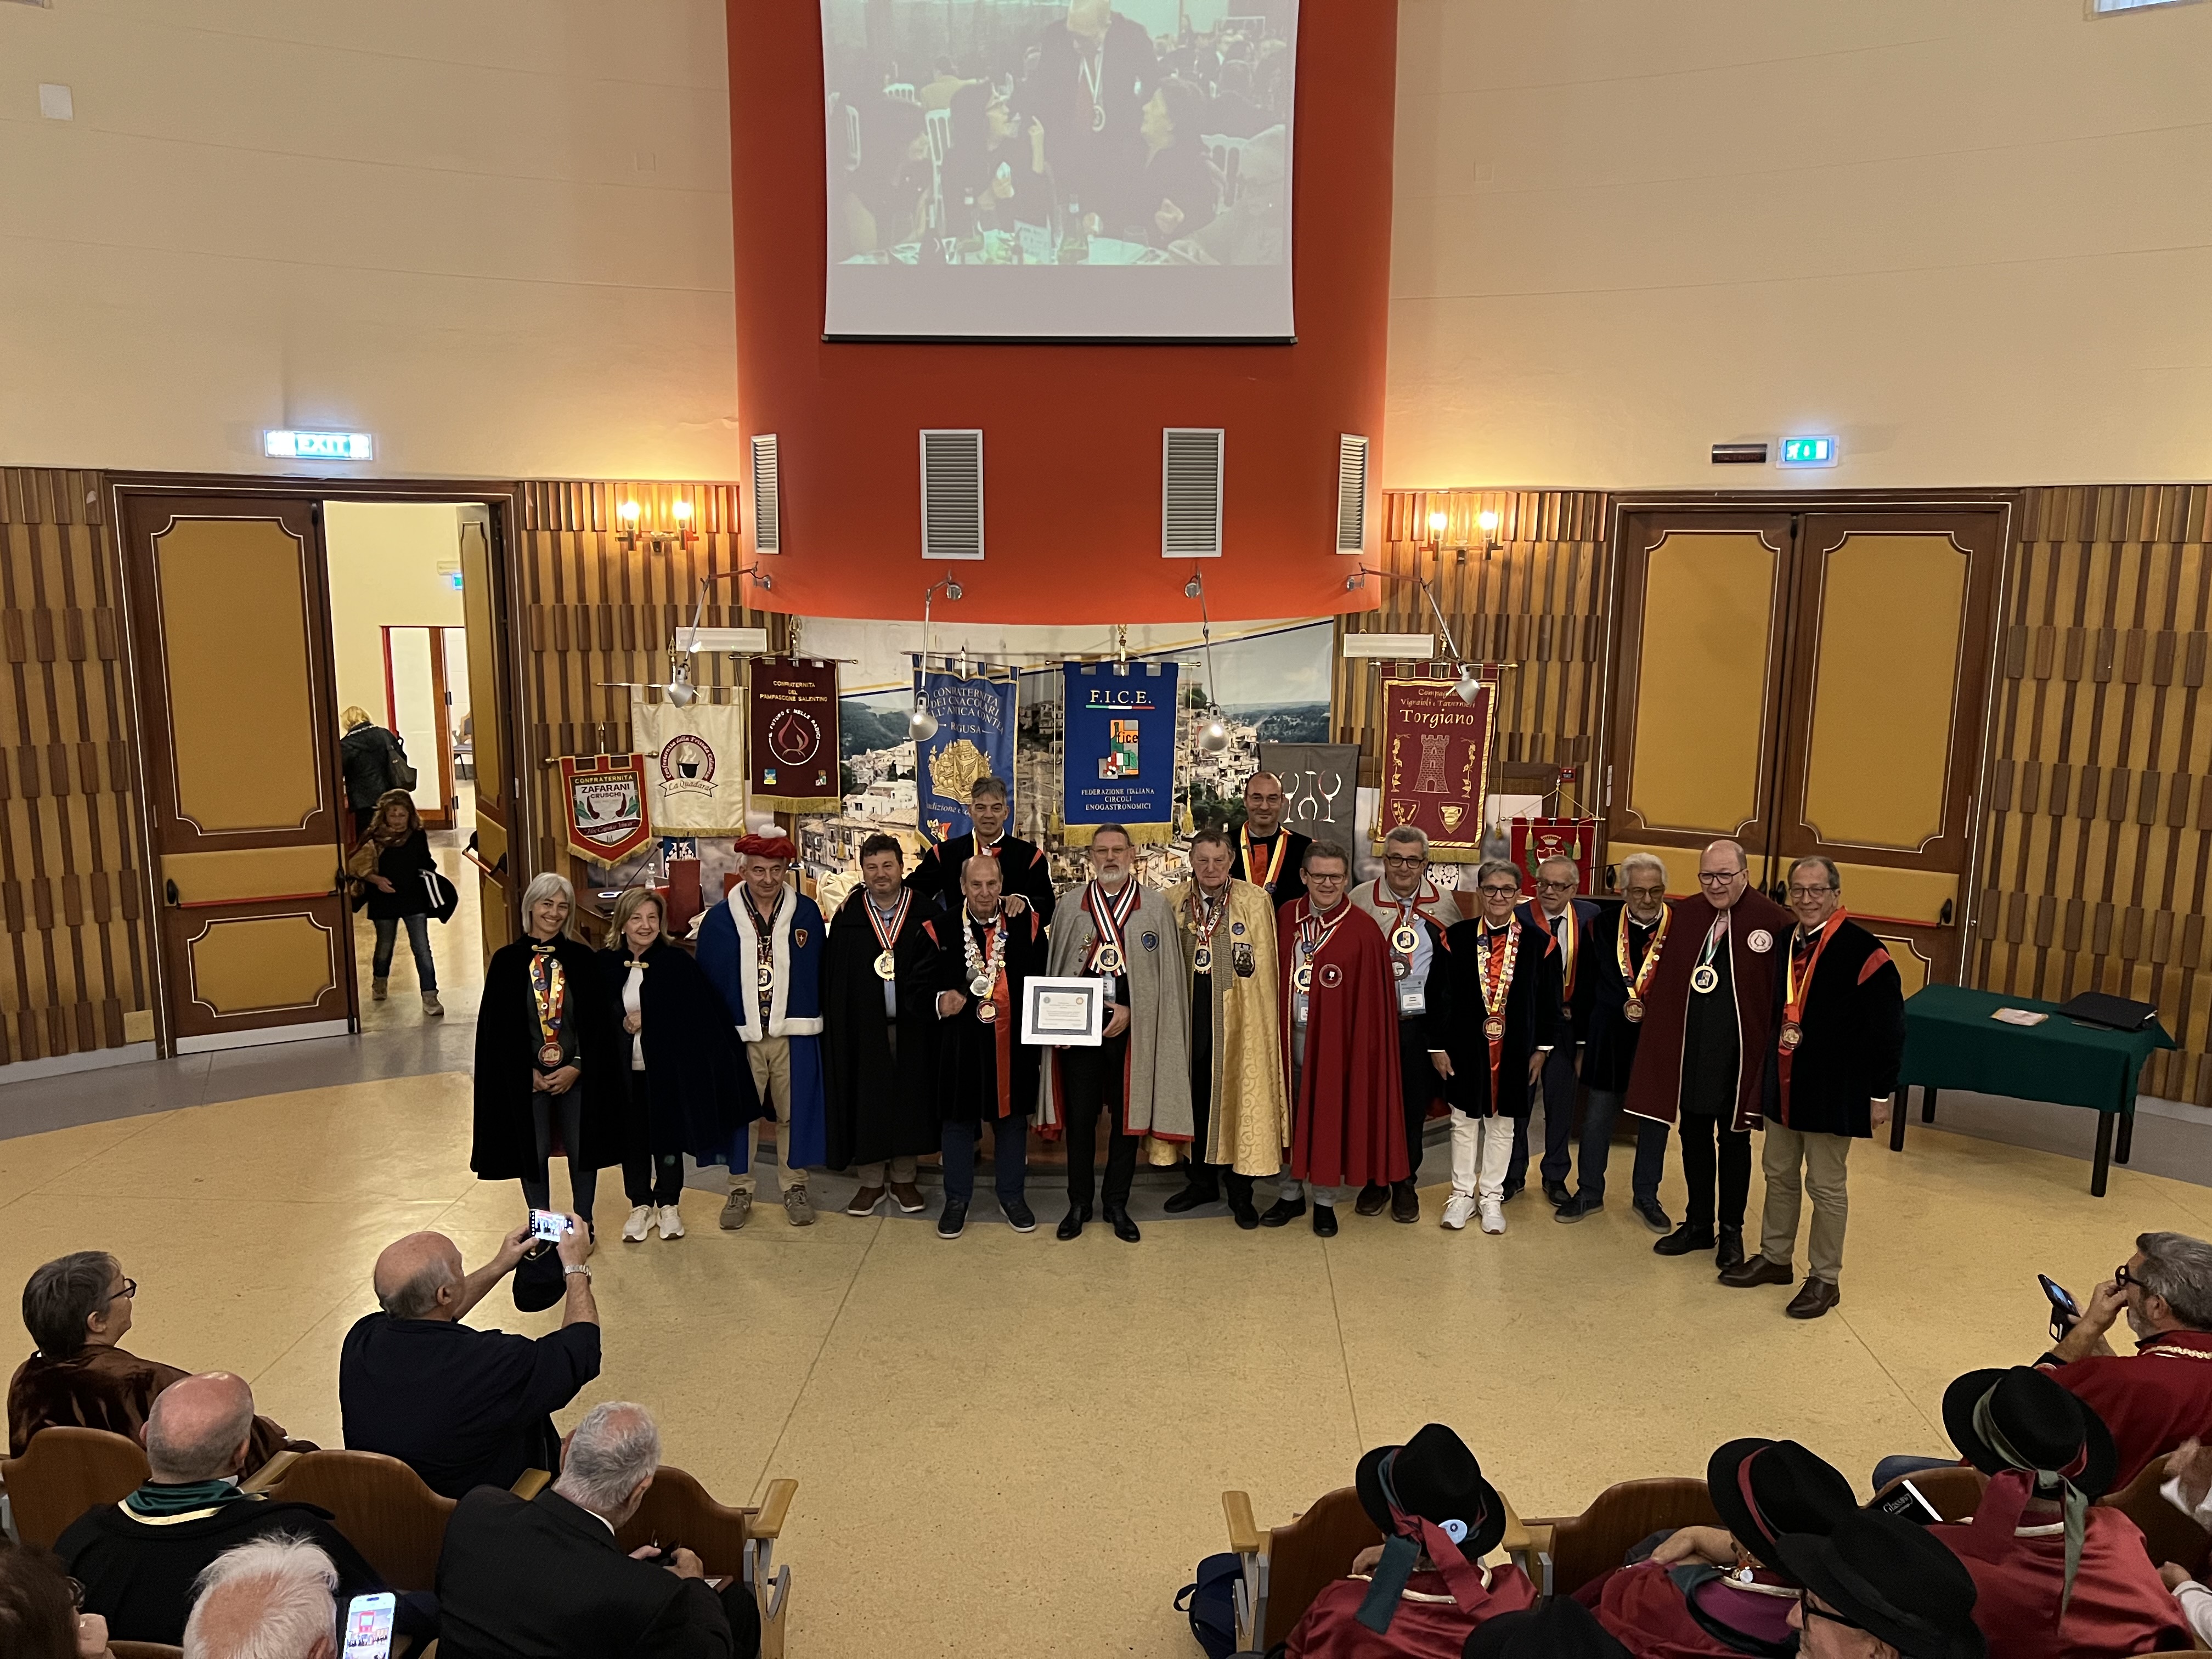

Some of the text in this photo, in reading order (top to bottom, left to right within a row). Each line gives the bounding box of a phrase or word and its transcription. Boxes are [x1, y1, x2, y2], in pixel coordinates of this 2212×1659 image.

[297, 435, 346, 452] EXIT
[930, 697, 946, 709] DEI
[1090, 690, 1152, 704] F.I.C.E.
[1401, 697, 1432, 708] Vignaioli
[769, 710, 785, 730] FUTURO
[793, 709, 811, 720] NELLE
[810, 719, 821, 740] RADICI
[1400, 708, 1475, 729] Torgiano
[950, 721, 981, 735] RGUSA
[1117, 731, 1139, 743] fice
[574, 775, 634, 784] CONFRATERNITA
[668, 780, 710, 791] La Quadara
[581, 783, 630, 794] ZAFARANI
[1085, 803, 1152, 811] ENOGASTRONOMICI
